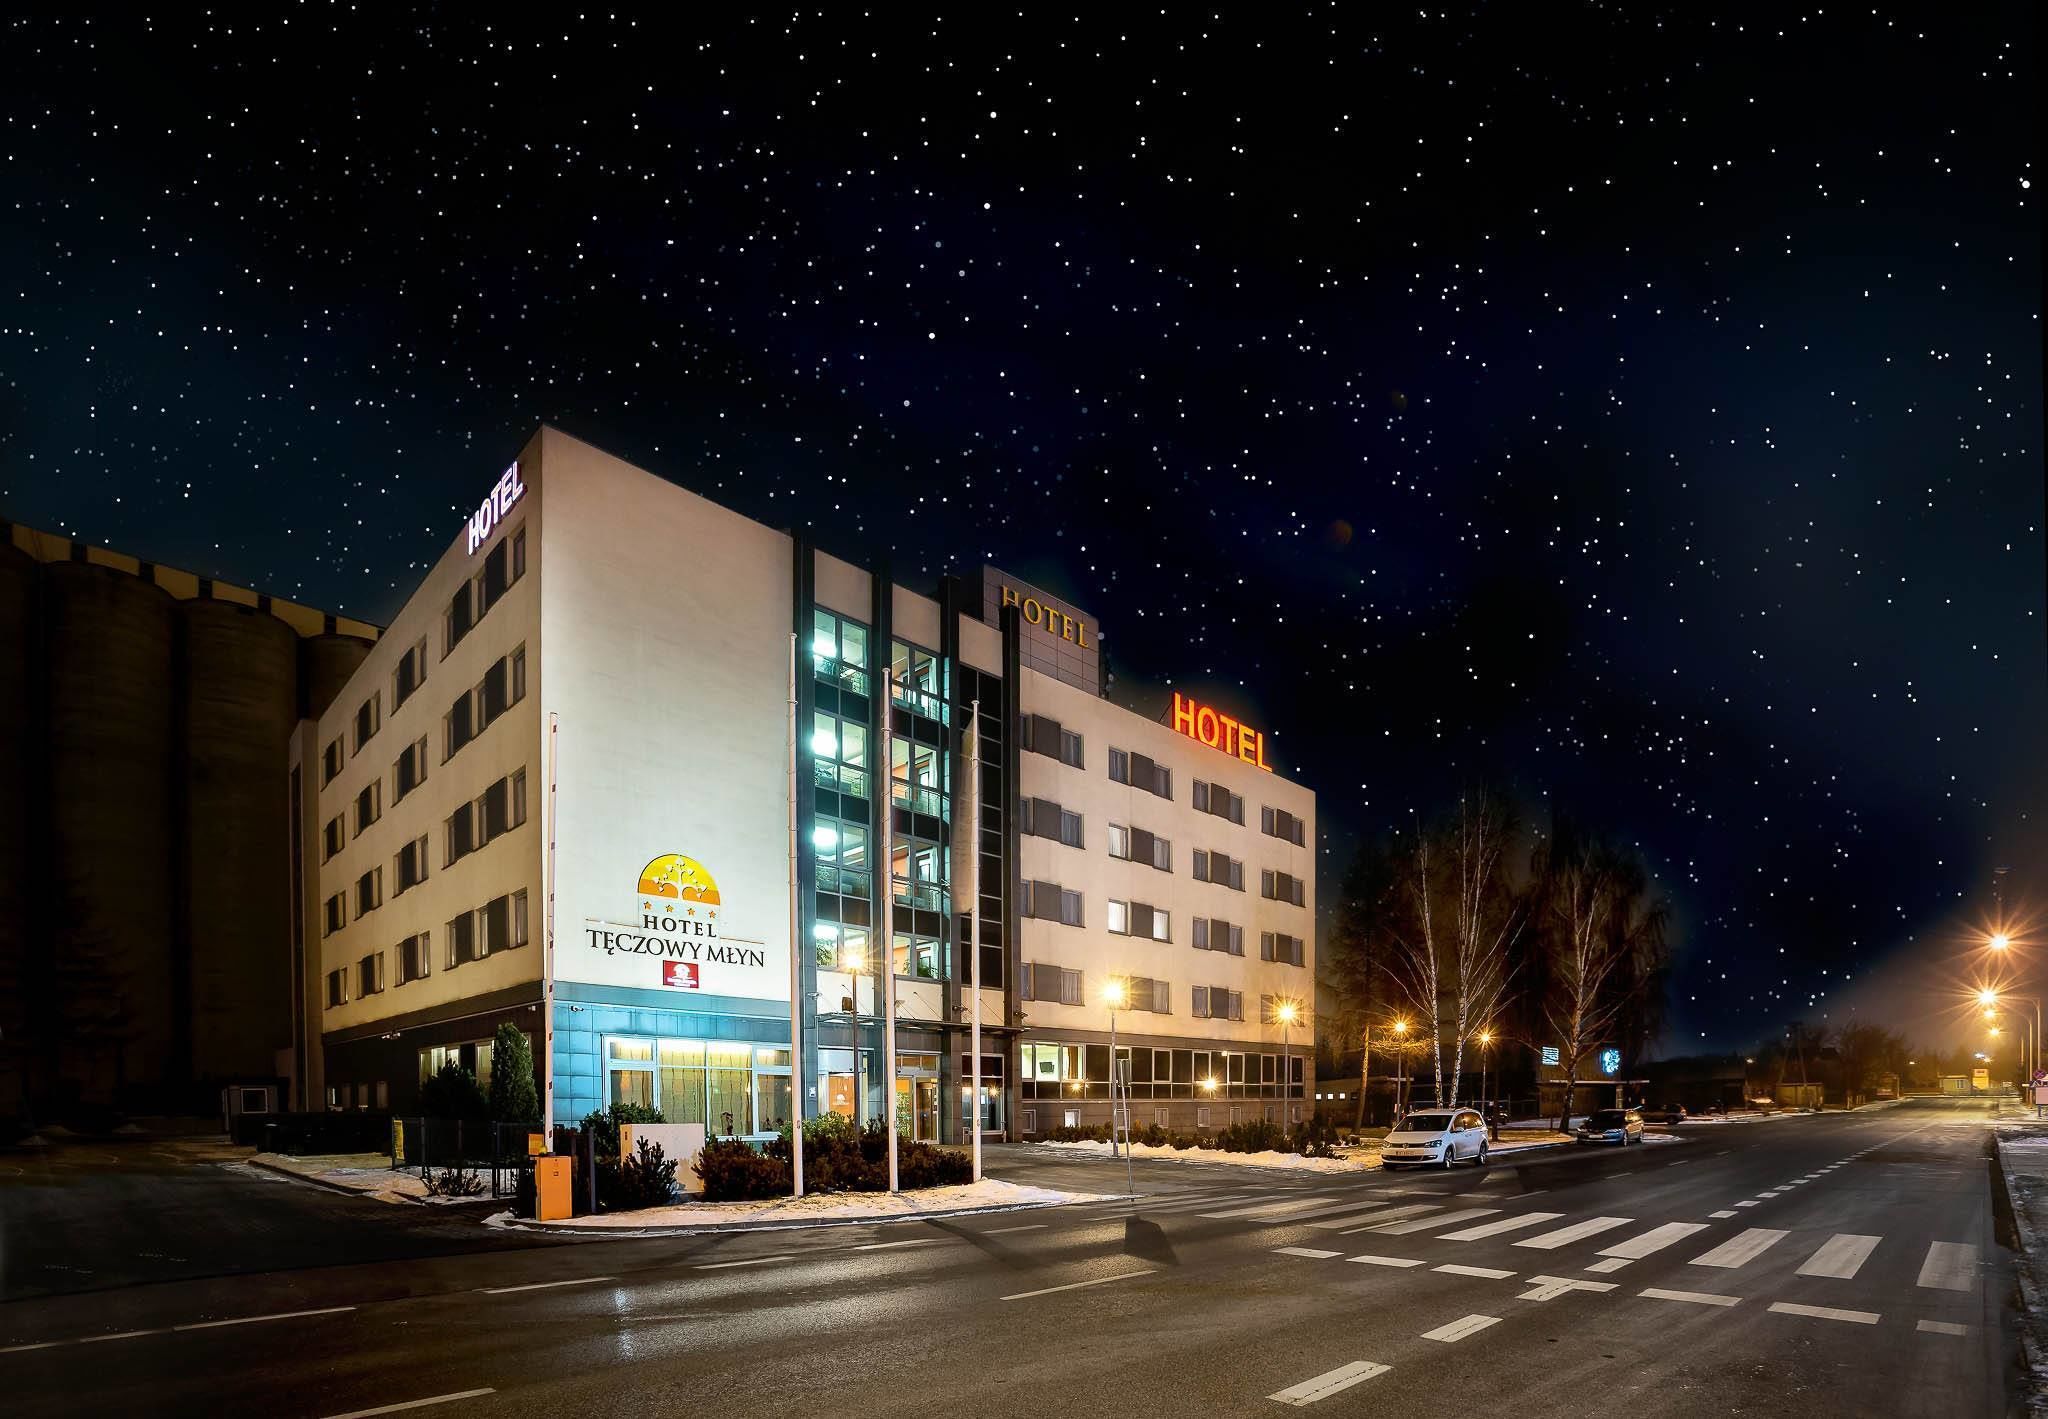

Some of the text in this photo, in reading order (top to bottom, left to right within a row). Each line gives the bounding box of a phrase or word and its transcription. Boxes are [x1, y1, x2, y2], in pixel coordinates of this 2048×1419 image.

[468, 460, 524, 555] HOTEL
[1000, 584, 1089, 648] HOTEL
[1172, 691, 1273, 773] HOTEL
[585, 928, 765, 968] TĘCZOWY MŁYN
[642, 914, 717, 938] HOTEL
